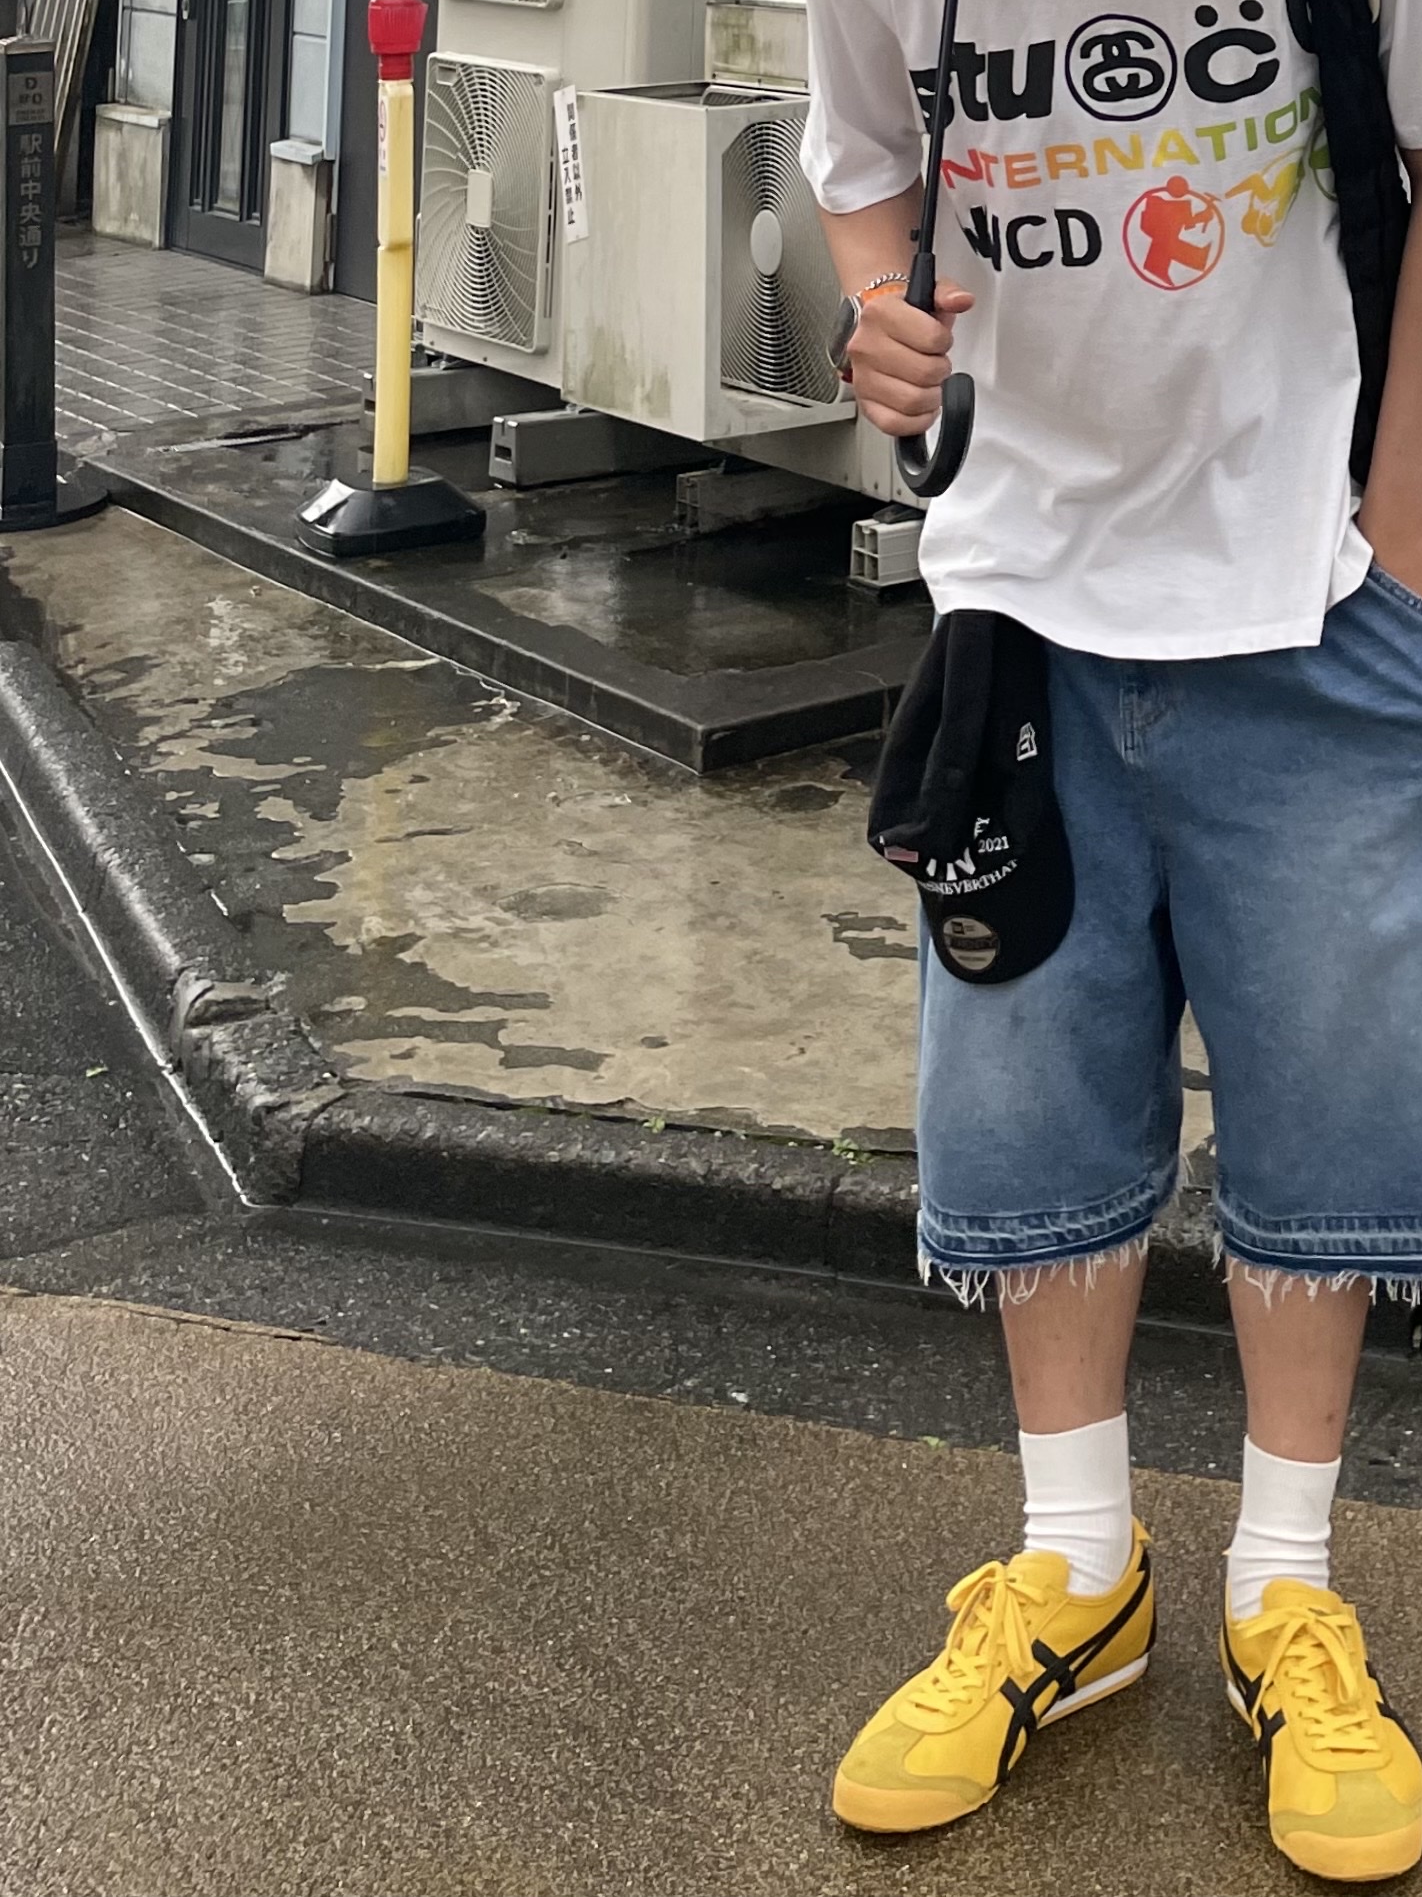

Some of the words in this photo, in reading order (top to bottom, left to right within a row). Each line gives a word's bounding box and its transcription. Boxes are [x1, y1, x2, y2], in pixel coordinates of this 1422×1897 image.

[561, 147, 576, 225] 立入禁止
[566, 103, 583, 202] 関係者以外
[19, 134, 43, 268] 駅前中央通り
[978, 836, 1009, 853] 2021
